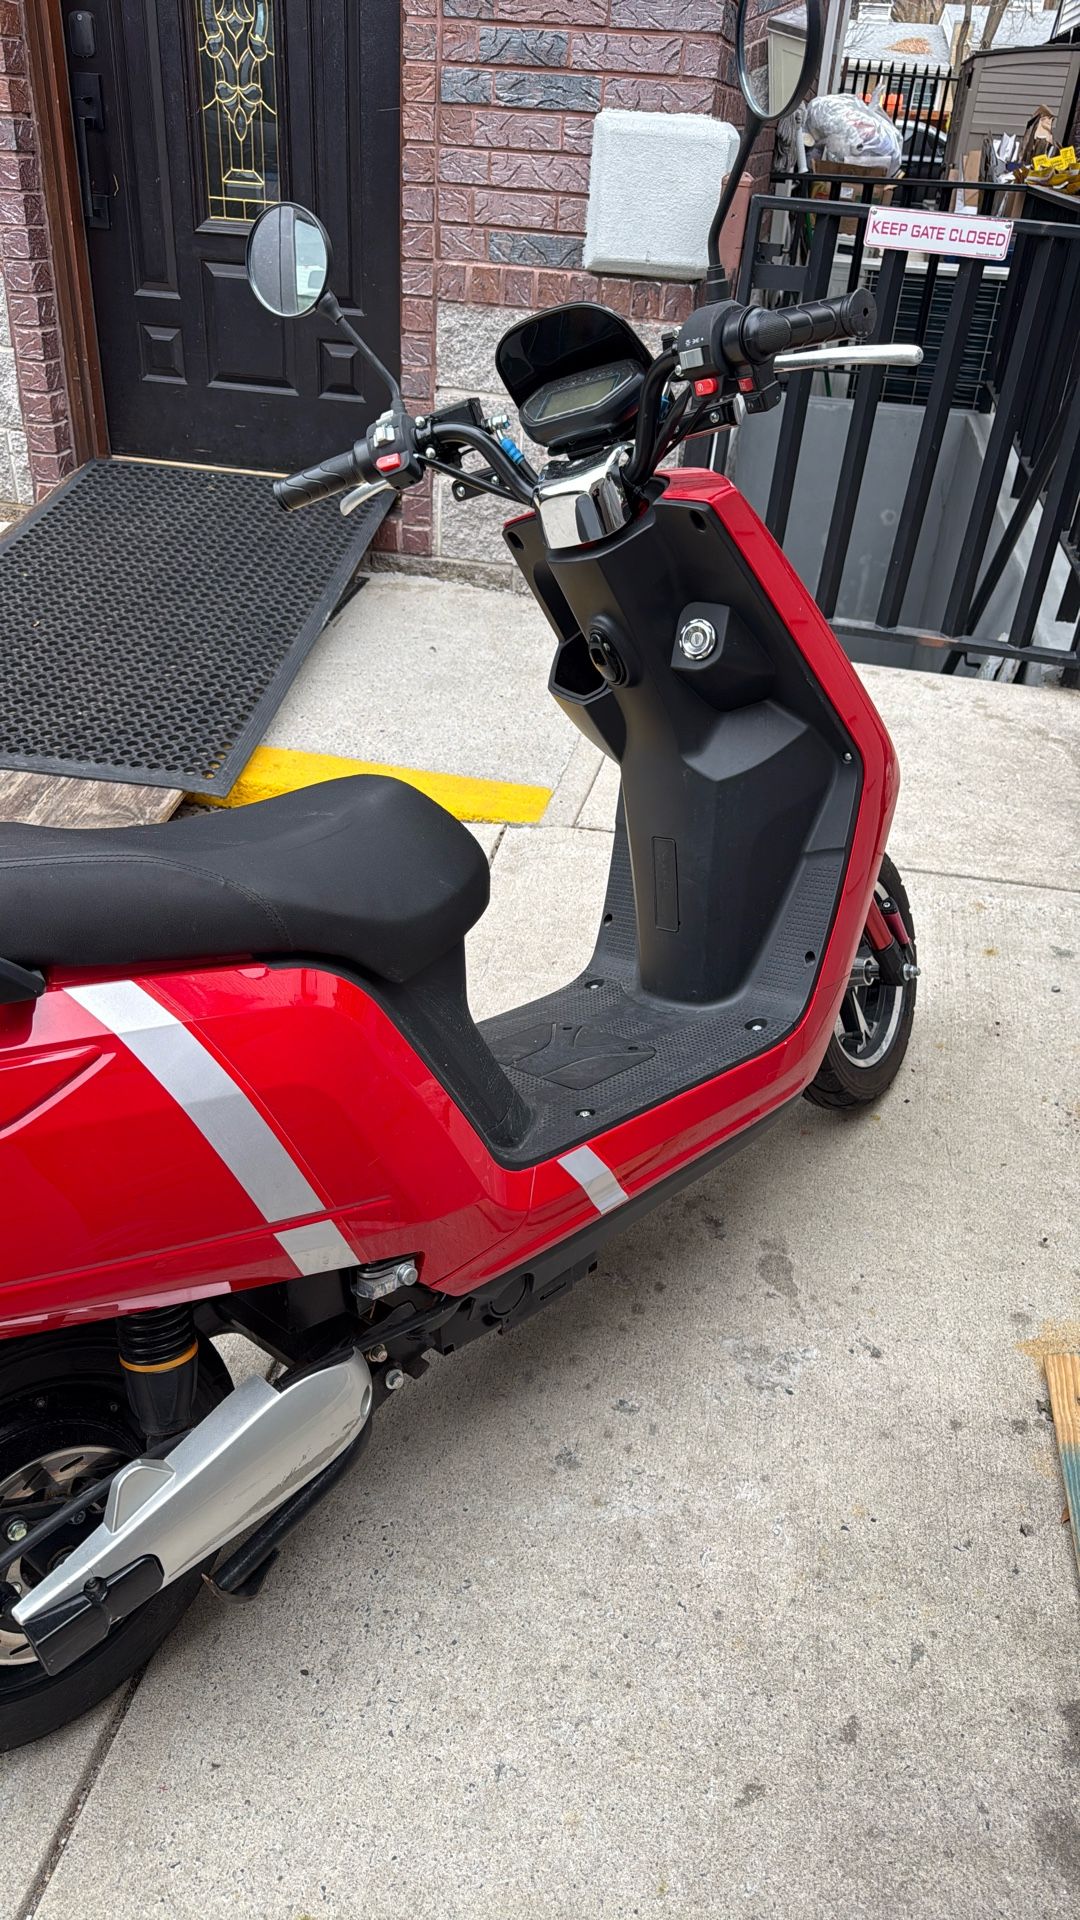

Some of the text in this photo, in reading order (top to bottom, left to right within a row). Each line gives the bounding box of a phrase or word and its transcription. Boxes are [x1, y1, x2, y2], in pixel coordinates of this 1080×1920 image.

[871, 220, 1006, 247] KEEP GATE CLOSED
